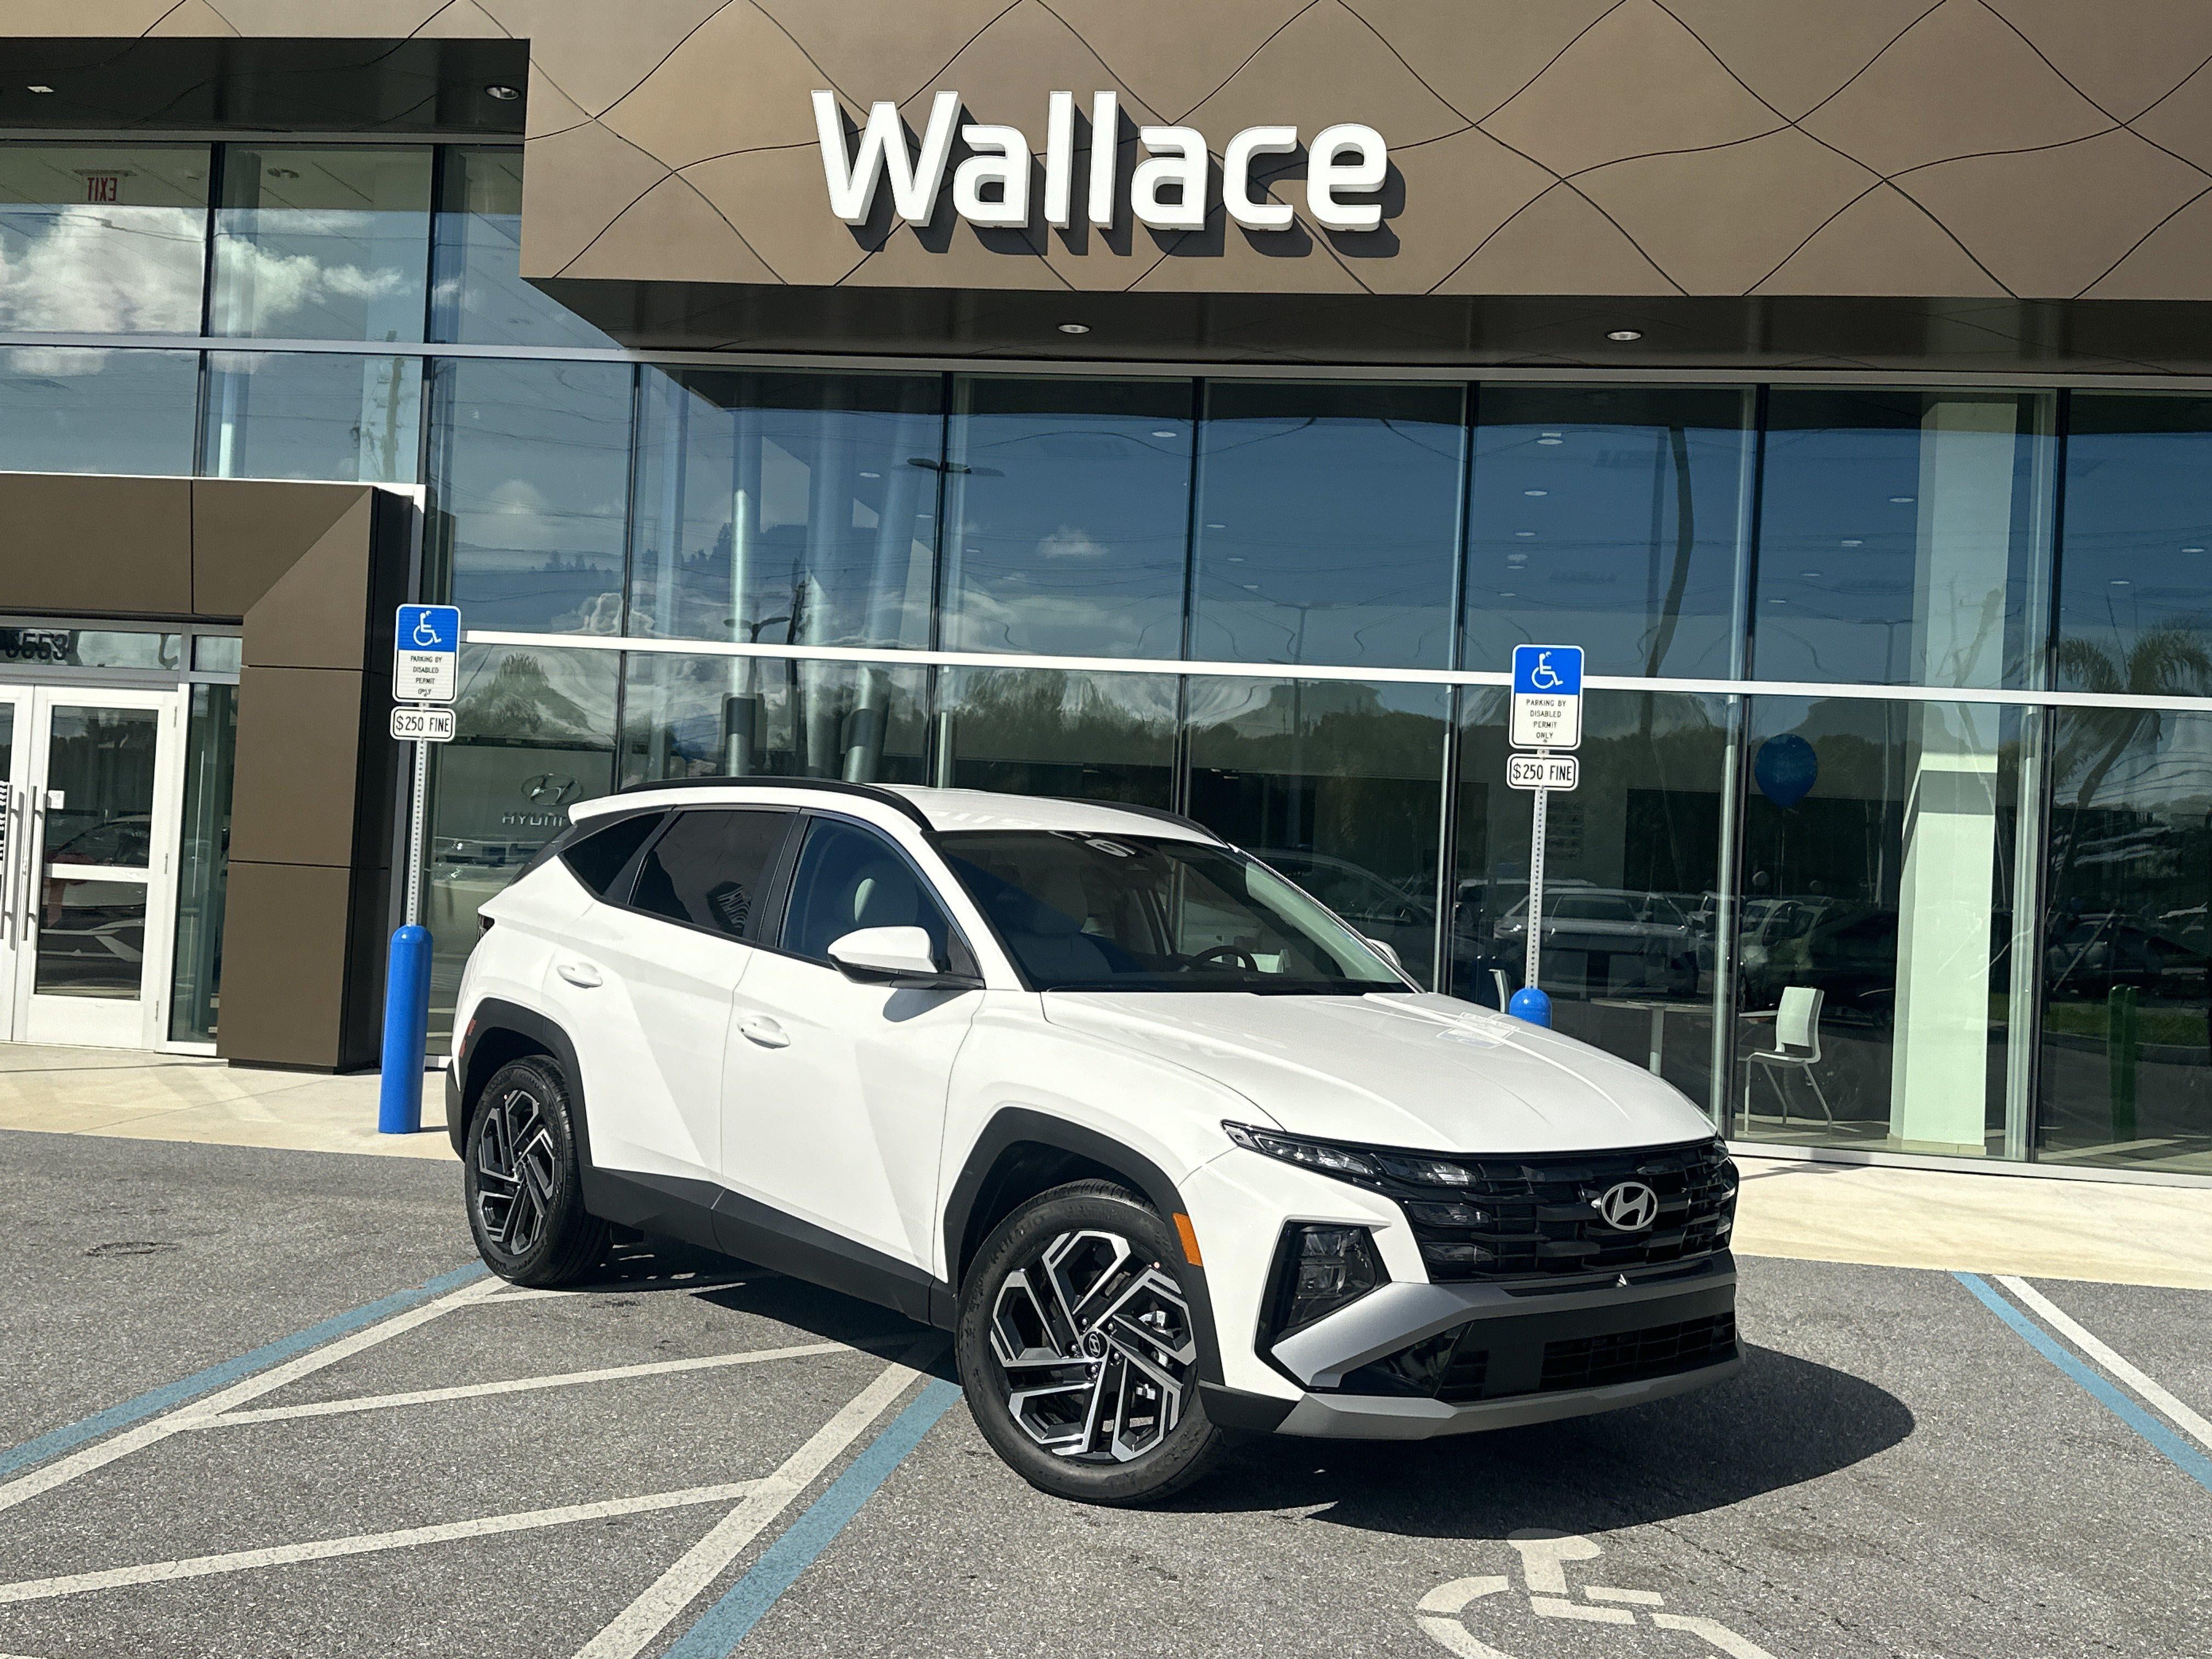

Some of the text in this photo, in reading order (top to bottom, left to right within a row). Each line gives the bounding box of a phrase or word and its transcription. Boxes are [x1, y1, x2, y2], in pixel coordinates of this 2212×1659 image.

[811, 89, 1389, 232] Wallace
[396, 715, 450, 732] $250 FINE
[1513, 763, 1573, 781] $250 FINE
